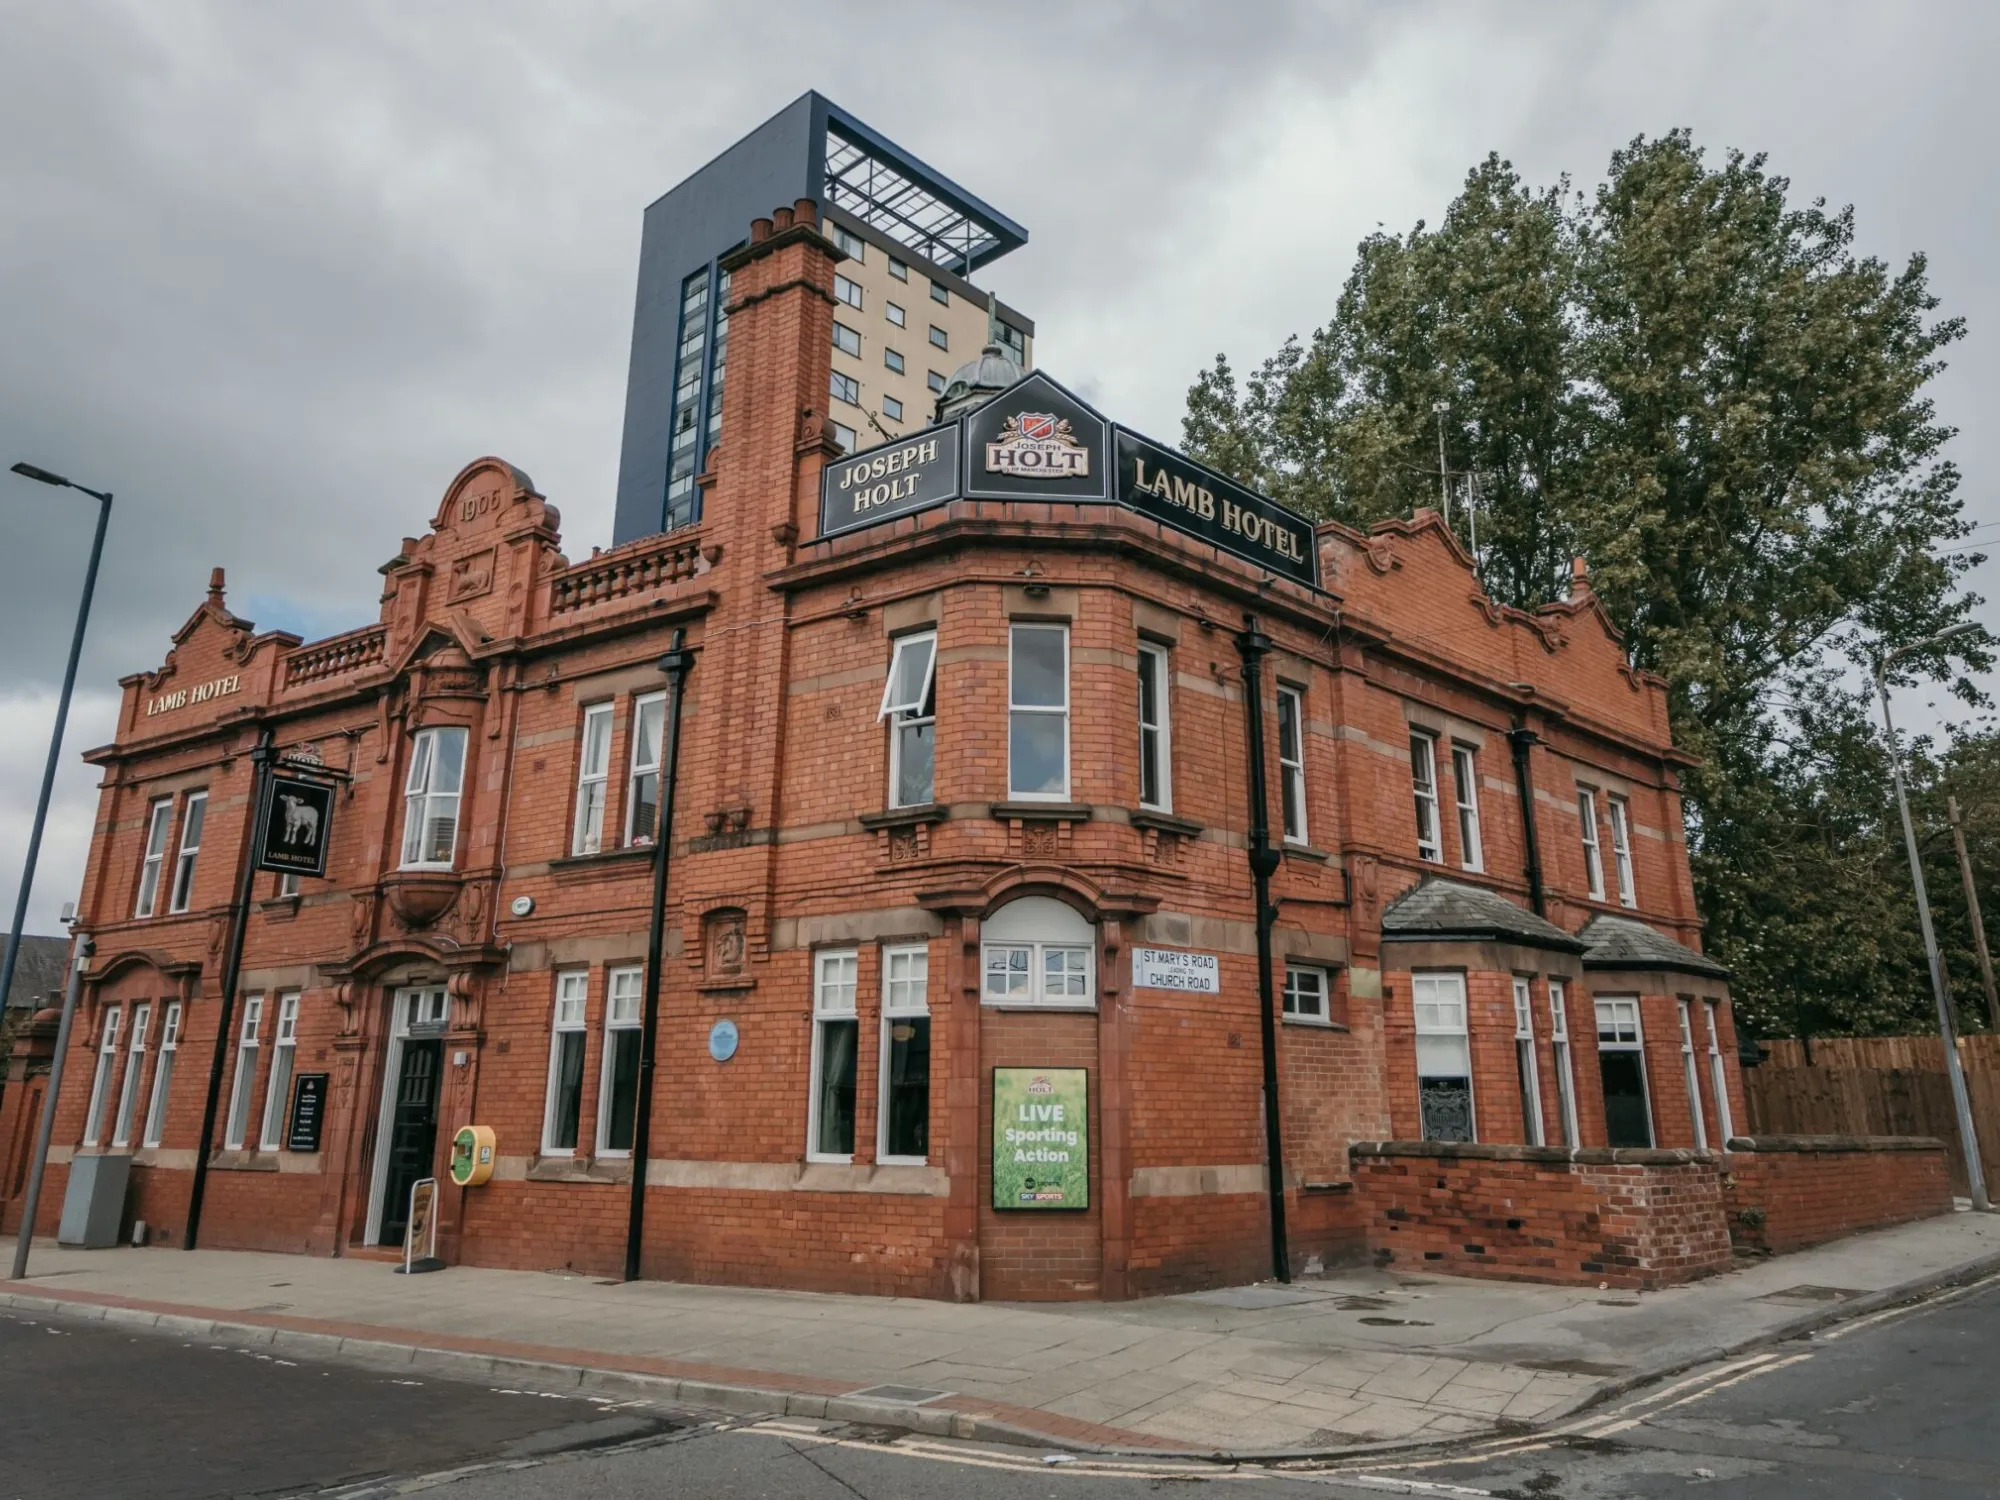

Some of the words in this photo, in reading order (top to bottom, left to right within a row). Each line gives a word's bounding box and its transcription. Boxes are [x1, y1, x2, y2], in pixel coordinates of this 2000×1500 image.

[1014, 442, 1061, 451] JOSEPH
[840, 440, 939, 490] JOSEPH
[993, 449, 1083, 469] HOLT
[853, 473, 921, 514] HOLT
[460, 488, 501, 523] 1906
[1134, 458, 1215, 521] LAMB
[1221, 499, 1303, 564] HOTEL
[146, 689, 187, 716] LAMB
[191, 675, 241, 704] HOTEL
[268, 851, 290, 860] LAMB
[291, 854, 315, 864] HOTEL
[1191, 955, 1214, 969] ROAD
[1150, 973, 1185, 988] CHURCH
[1187, 976, 1210, 990] ROAD
[1019, 1103, 1064, 1122] LIVE
[1005, 1127, 1078, 1147] Sporting
[1013, 1146, 1069, 1162] Action
